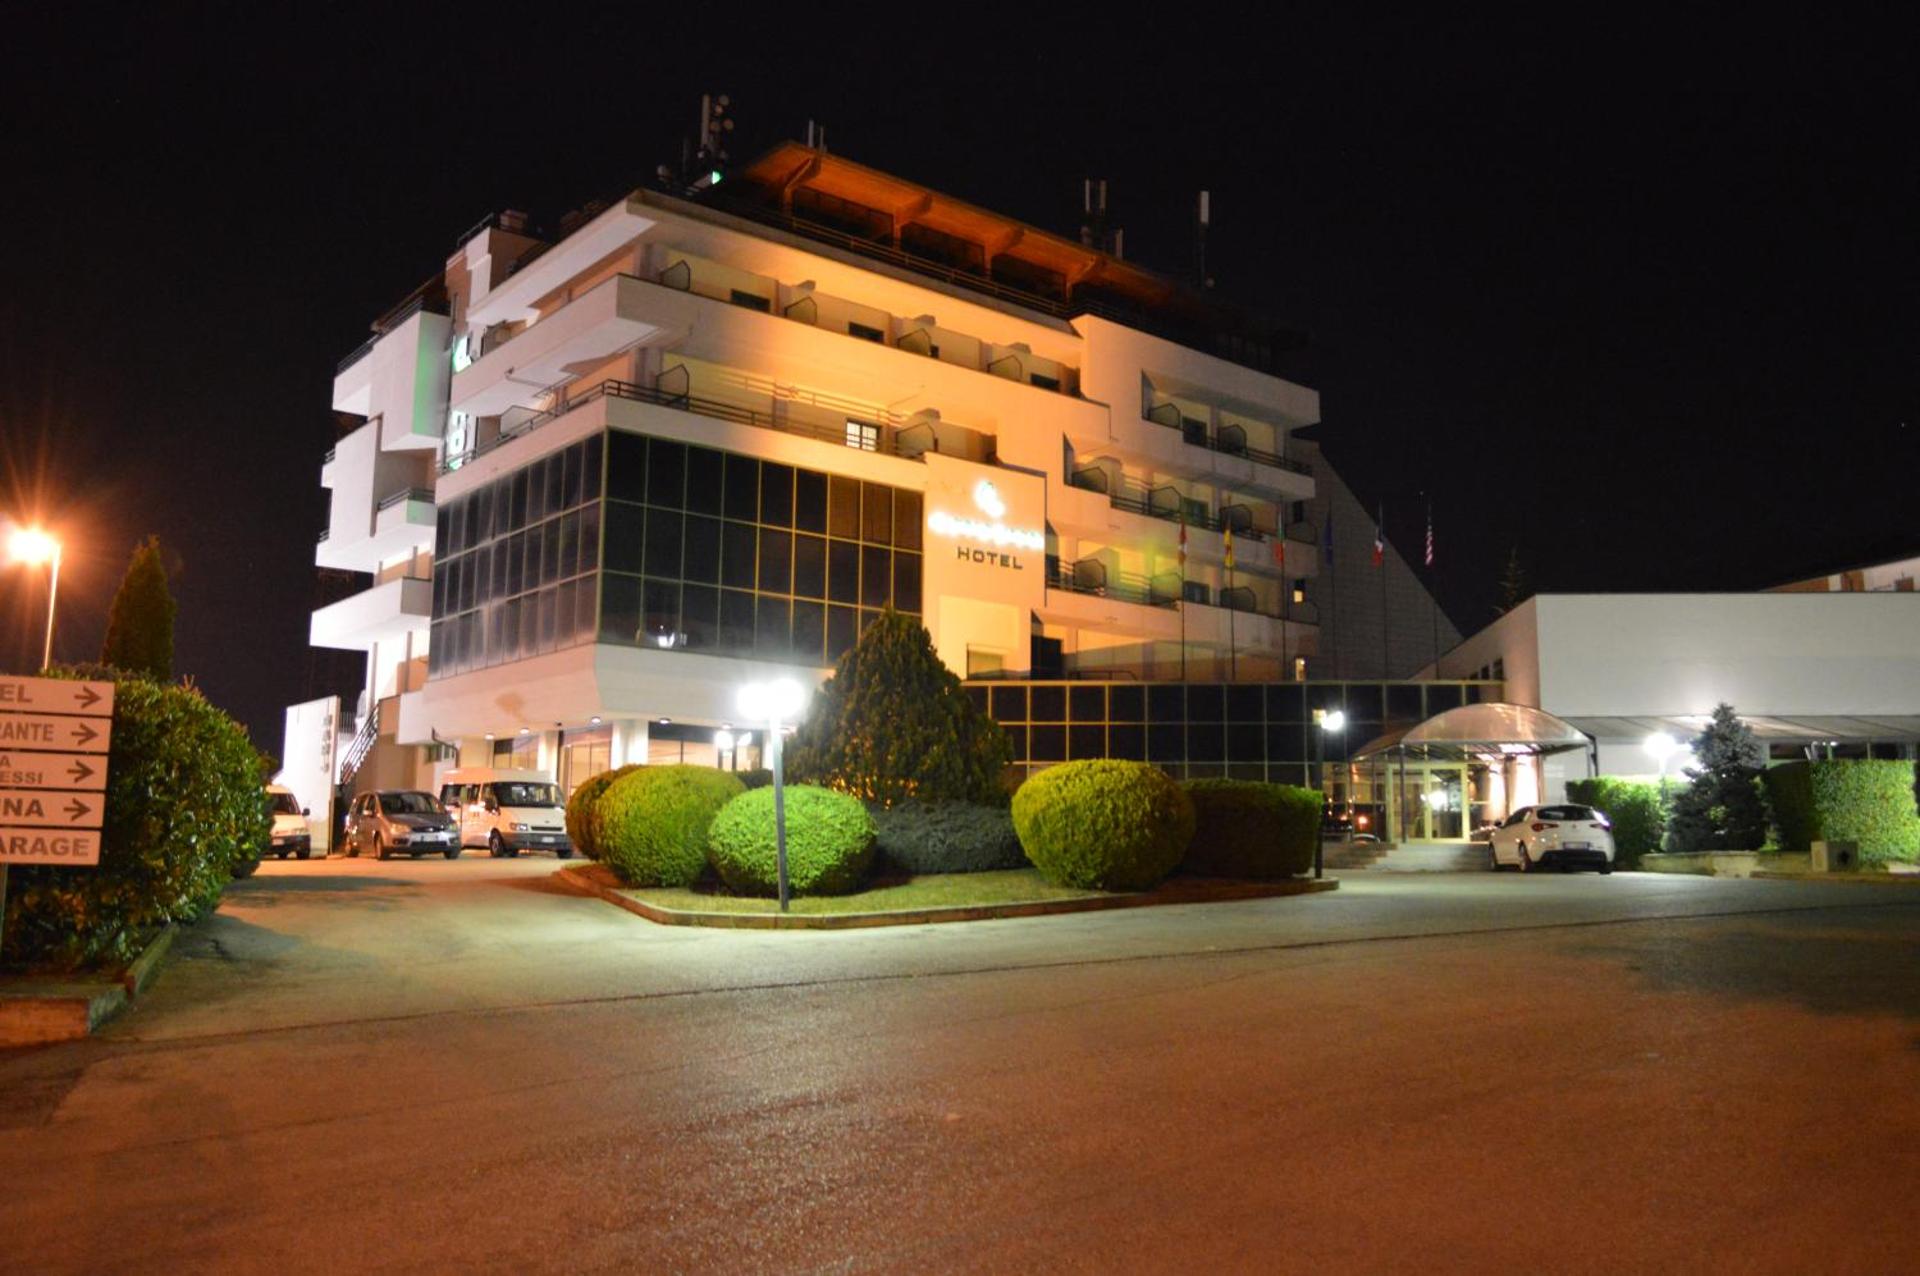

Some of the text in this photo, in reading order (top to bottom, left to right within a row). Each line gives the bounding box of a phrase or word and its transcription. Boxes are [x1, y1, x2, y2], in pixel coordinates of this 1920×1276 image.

[957, 546, 1023, 570] HOTEL
[0, 684, 32, 703] EL
[0, 721, 55, 742] ANTE
[0, 798, 44, 817] NA
